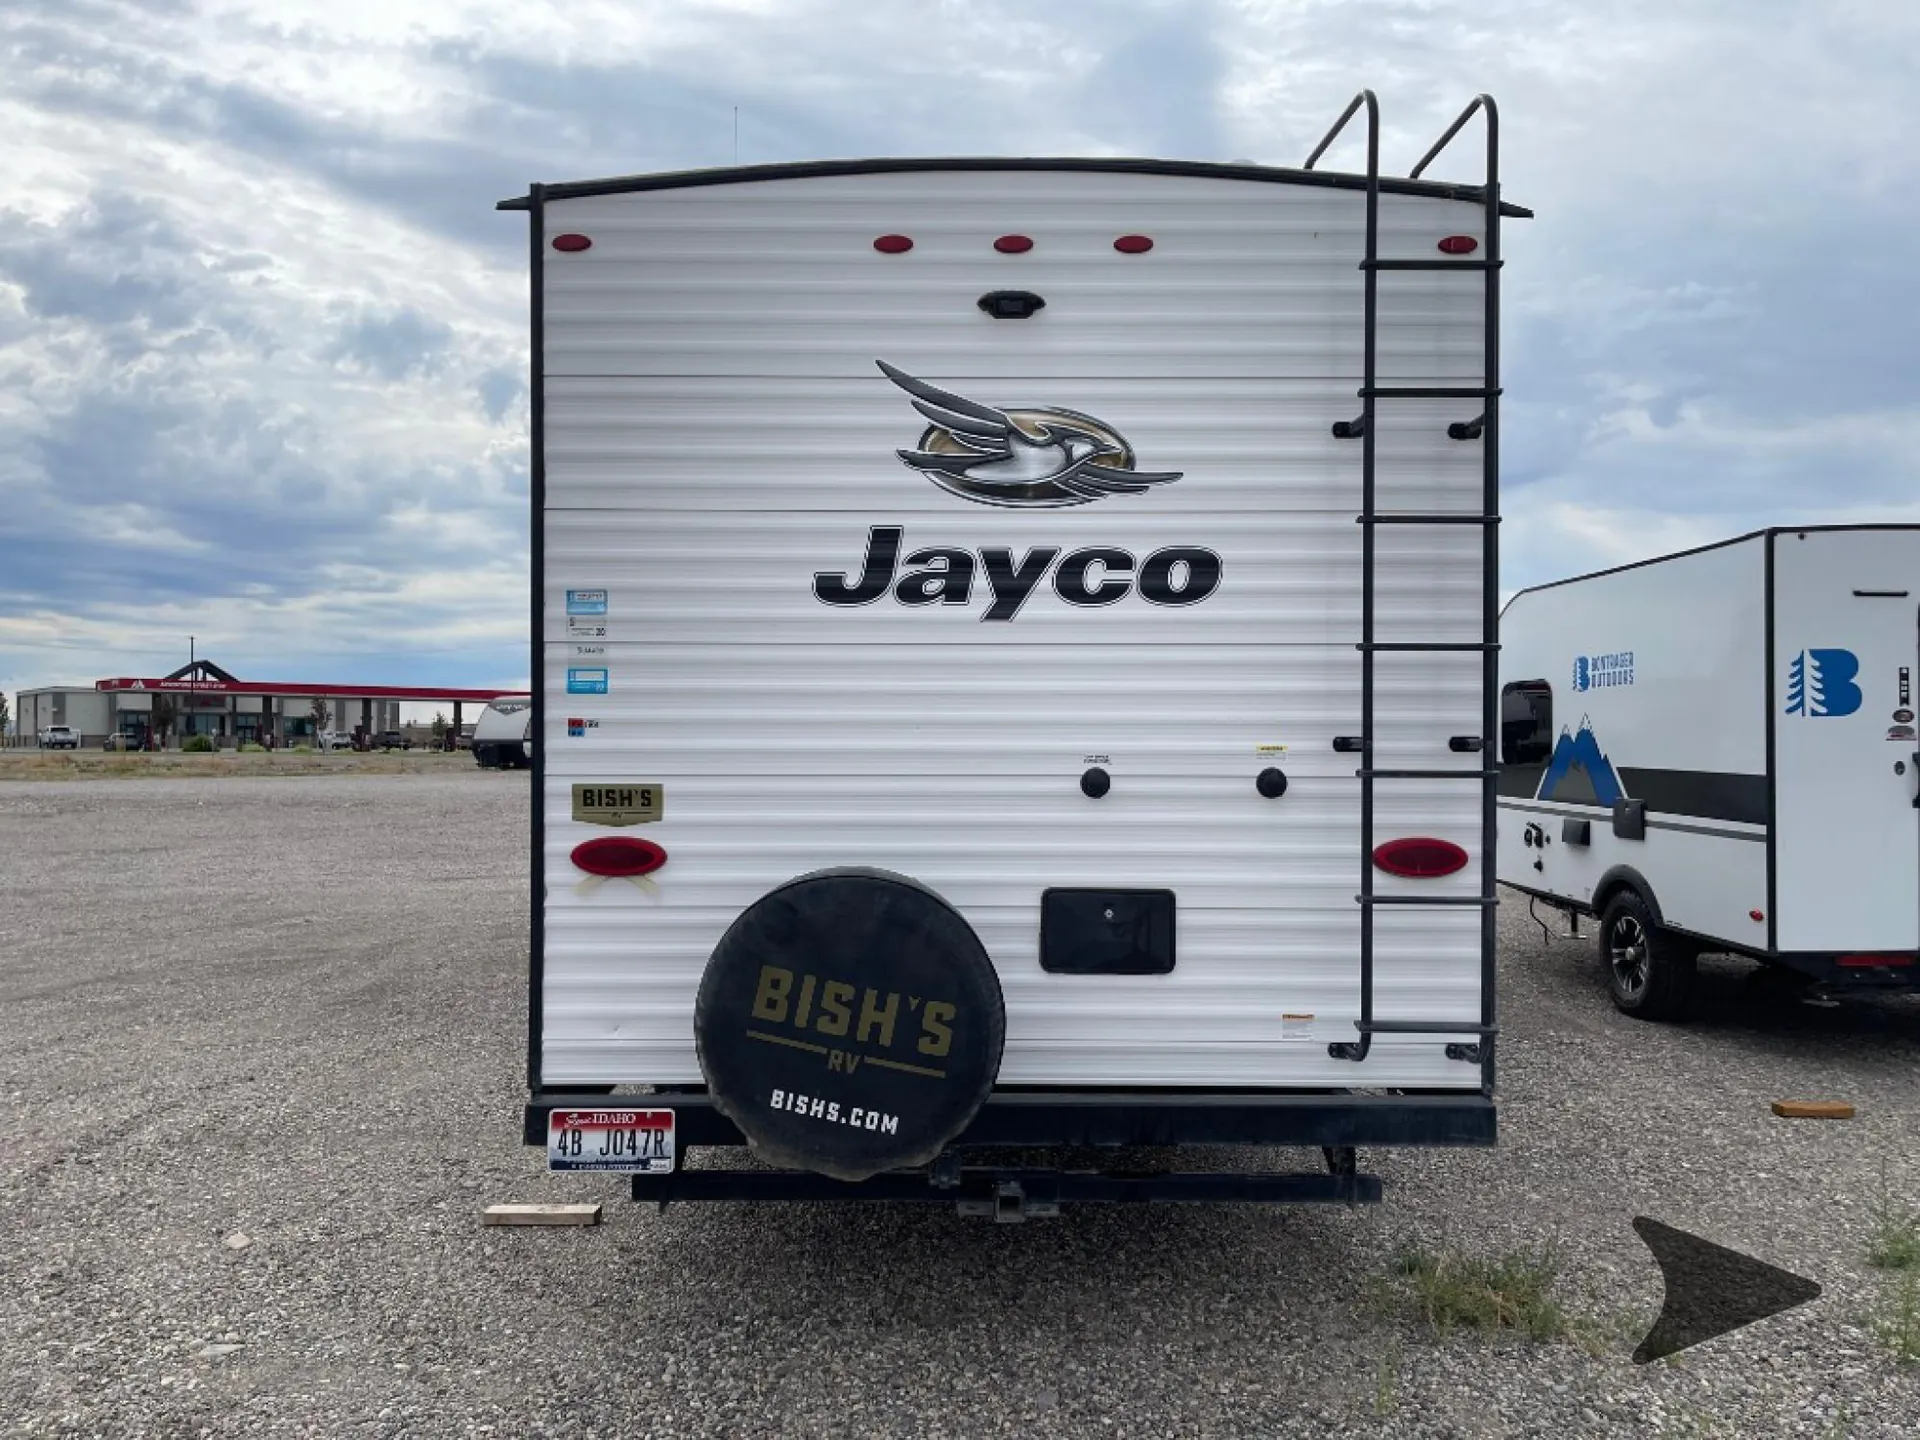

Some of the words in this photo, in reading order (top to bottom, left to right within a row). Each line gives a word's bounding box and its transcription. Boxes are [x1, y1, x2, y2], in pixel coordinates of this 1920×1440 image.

[812, 525, 1223, 622] Jayco
[1591, 669, 1634, 688] OUTDOORS
[582, 789, 652, 807] BISH'S
[751, 965, 957, 1057] BISH'S
[826, 1049, 864, 1075] RV
[592, 1113, 637, 1124] IDAHO
[770, 1088, 900, 1136] BISHS.COM
[557, 1129, 582, 1156] 4B
[599, 1129, 666, 1156] J047R
